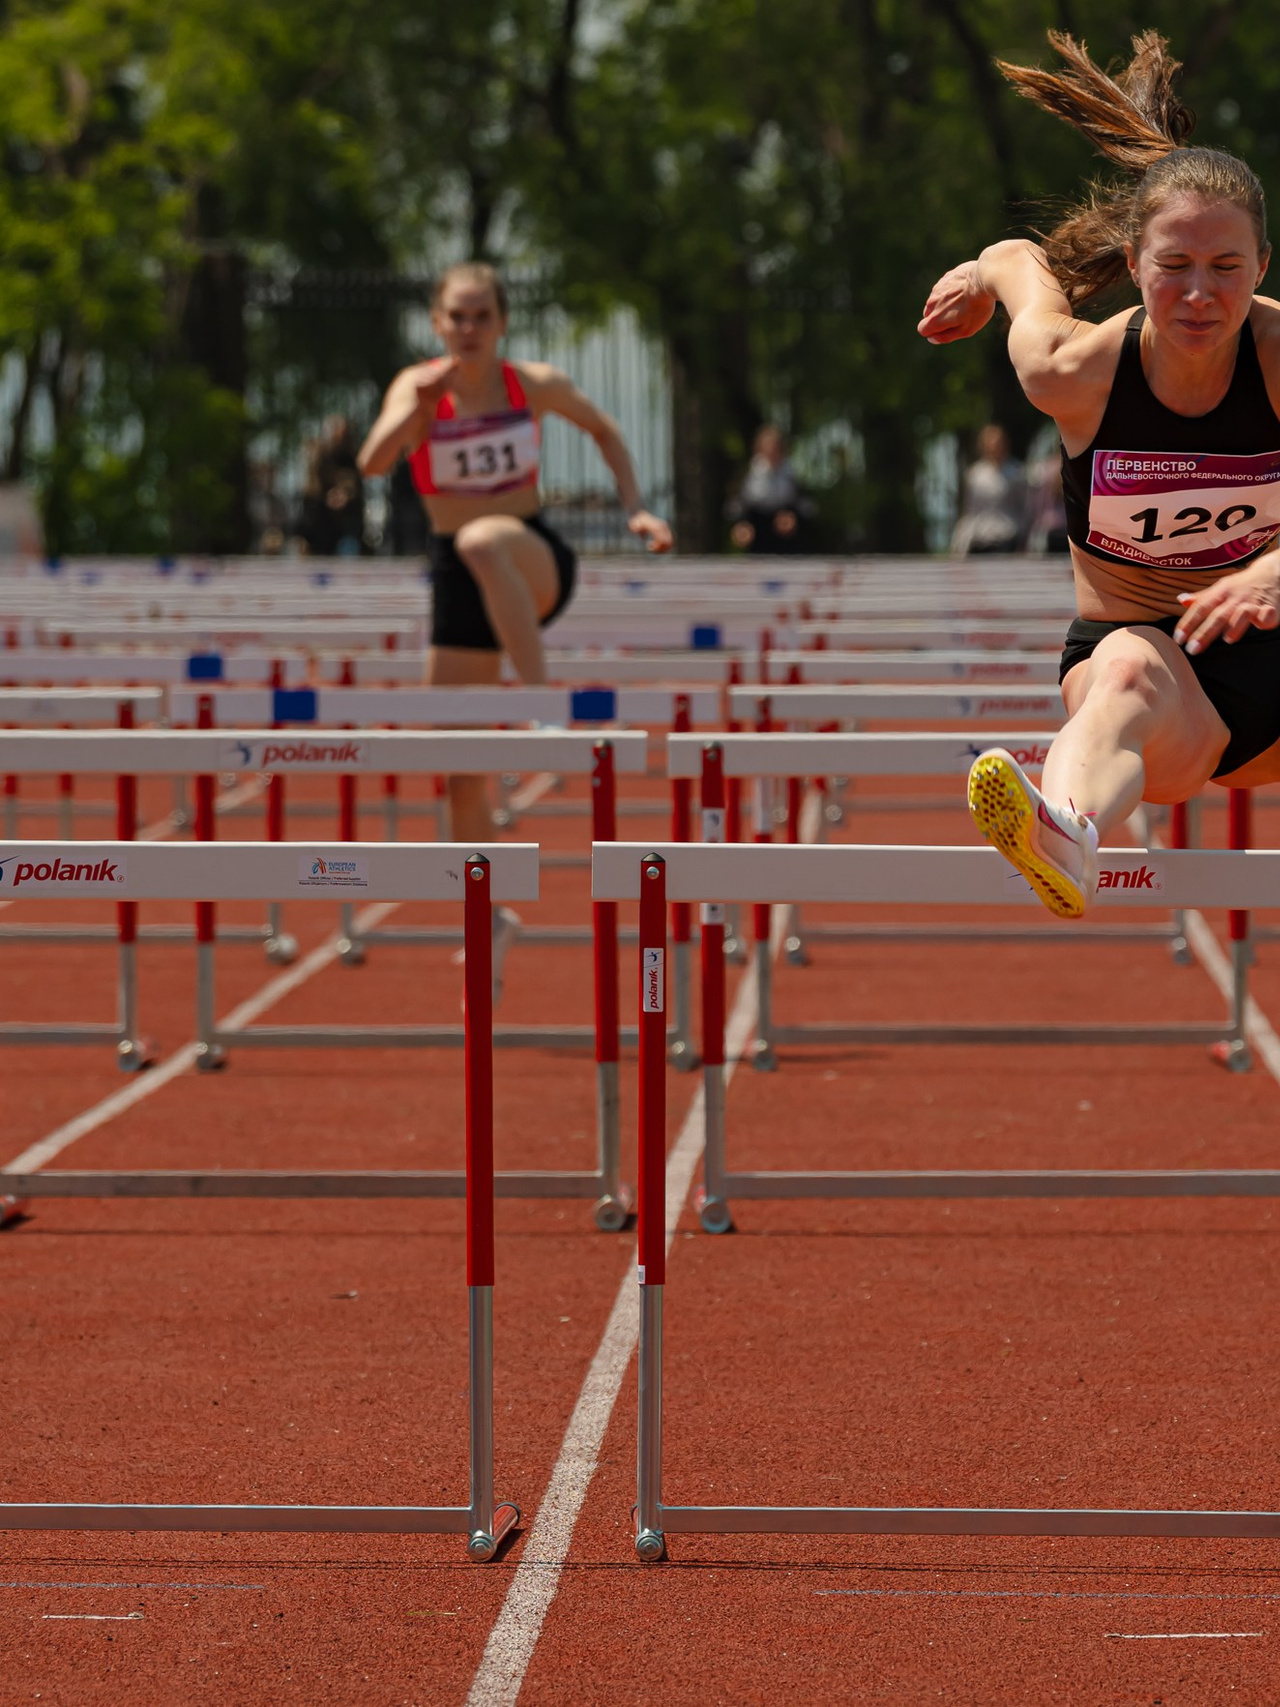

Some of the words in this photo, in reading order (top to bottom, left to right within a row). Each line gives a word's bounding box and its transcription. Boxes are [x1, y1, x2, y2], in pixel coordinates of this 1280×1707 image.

[455, 442, 516, 478] 131
[1107, 459, 1196, 471] ПЕРВЕНСТВО
[1106, 472, 1189, 480] ДАЛЬНЕВОСТОЧНОГО
[1191, 472, 1253, 481] ФЕДЕРАЛЬНОГО
[1129, 504, 1257, 543] 120
[1098, 865, 1156, 889] anik
